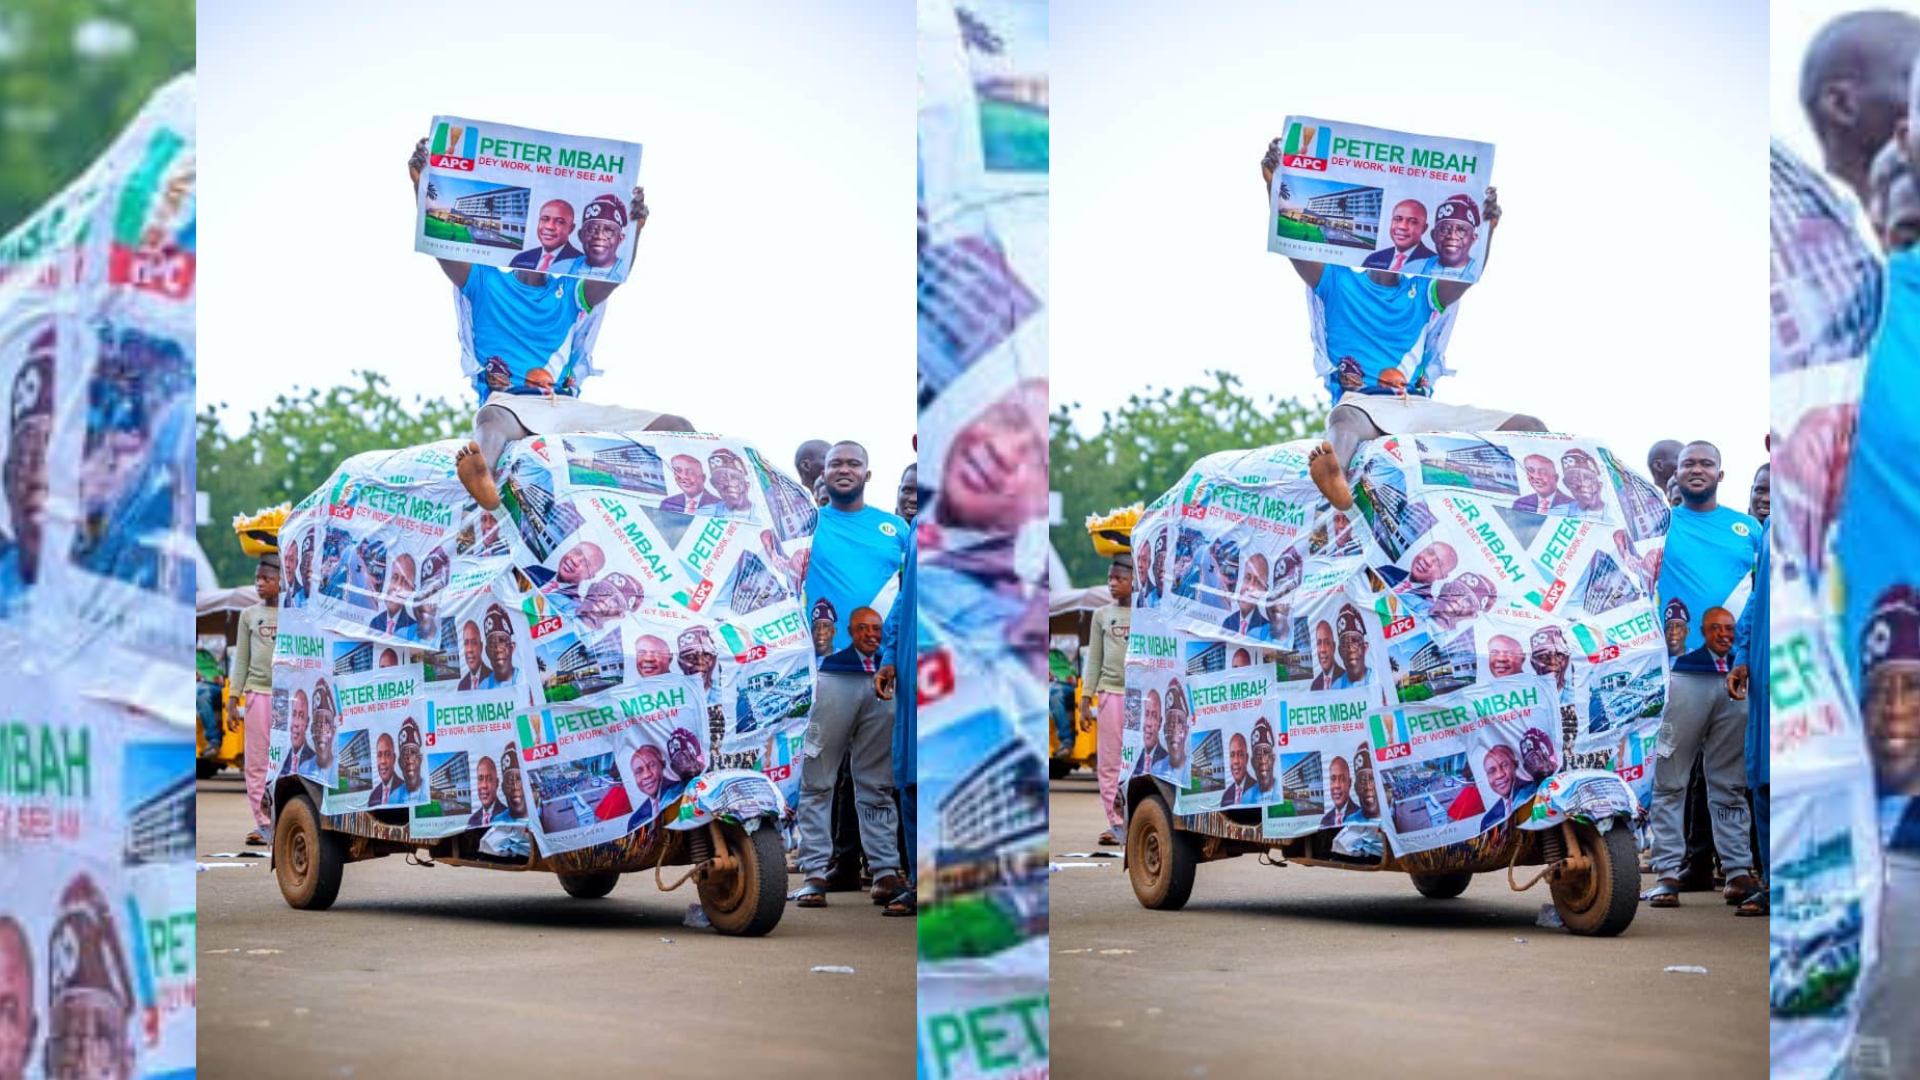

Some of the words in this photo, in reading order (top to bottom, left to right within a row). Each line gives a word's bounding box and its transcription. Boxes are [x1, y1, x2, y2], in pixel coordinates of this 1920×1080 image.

[438, 157, 469, 170] APC
[480, 137, 553, 165] PETER
[558, 149, 624, 174] MBAH
[1291, 157, 1322, 170] APC
[1333, 137, 1406, 165] PETER
[1411, 149, 1477, 174] MBAH
[478, 157, 499, 168] DEY
[536, 165, 552, 175] WE
[554, 167, 575, 178] DEY
[576, 170, 596, 181] SEE
[597, 174, 614, 184] AM
[1331, 157, 1352, 168] DEY
[1389, 165, 1405, 175] WE
[1407, 167, 1428, 178] DEY
[1429, 170, 1449, 181] SEE
[1450, 174, 1467, 184] AM
[360, 485, 407, 515] PETER
[410, 496, 452, 526] MBAH
[1213, 485, 1260, 515] PETER
[1263, 496, 1305, 526] MBAH
[623, 523, 673, 582] MBAH
[1476, 523, 1526, 582] MBAH
[694, 582, 713, 605] APC
[1547, 582, 1566, 605] APC
[537, 618, 560, 636] APC
[1390, 618, 1413, 636] APC
[295, 636, 325, 657] MBAH
[1148, 636, 1178, 657] MBAH
[339, 685, 375, 706] PETER
[378, 679, 414, 701] MBAH
[1192, 685, 1228, 706] PETER
[1231, 679, 1267, 701] MBAH
[436, 705, 475, 726] PETER
[555, 706, 617, 735] PETER
[620, 687, 684, 717] MBAH
[1289, 705, 1328, 726] PETER
[1408, 706, 1470, 735] PETER
[1473, 687, 1537, 717] MBAH
[558, 735, 575, 746] DEY
[608, 723, 623, 734] WE
[1411, 735, 1428, 746] DEY
[1461, 723, 1476, 734] WE
[532, 744, 555, 760] APC
[1385, 744, 1408, 760] APC
